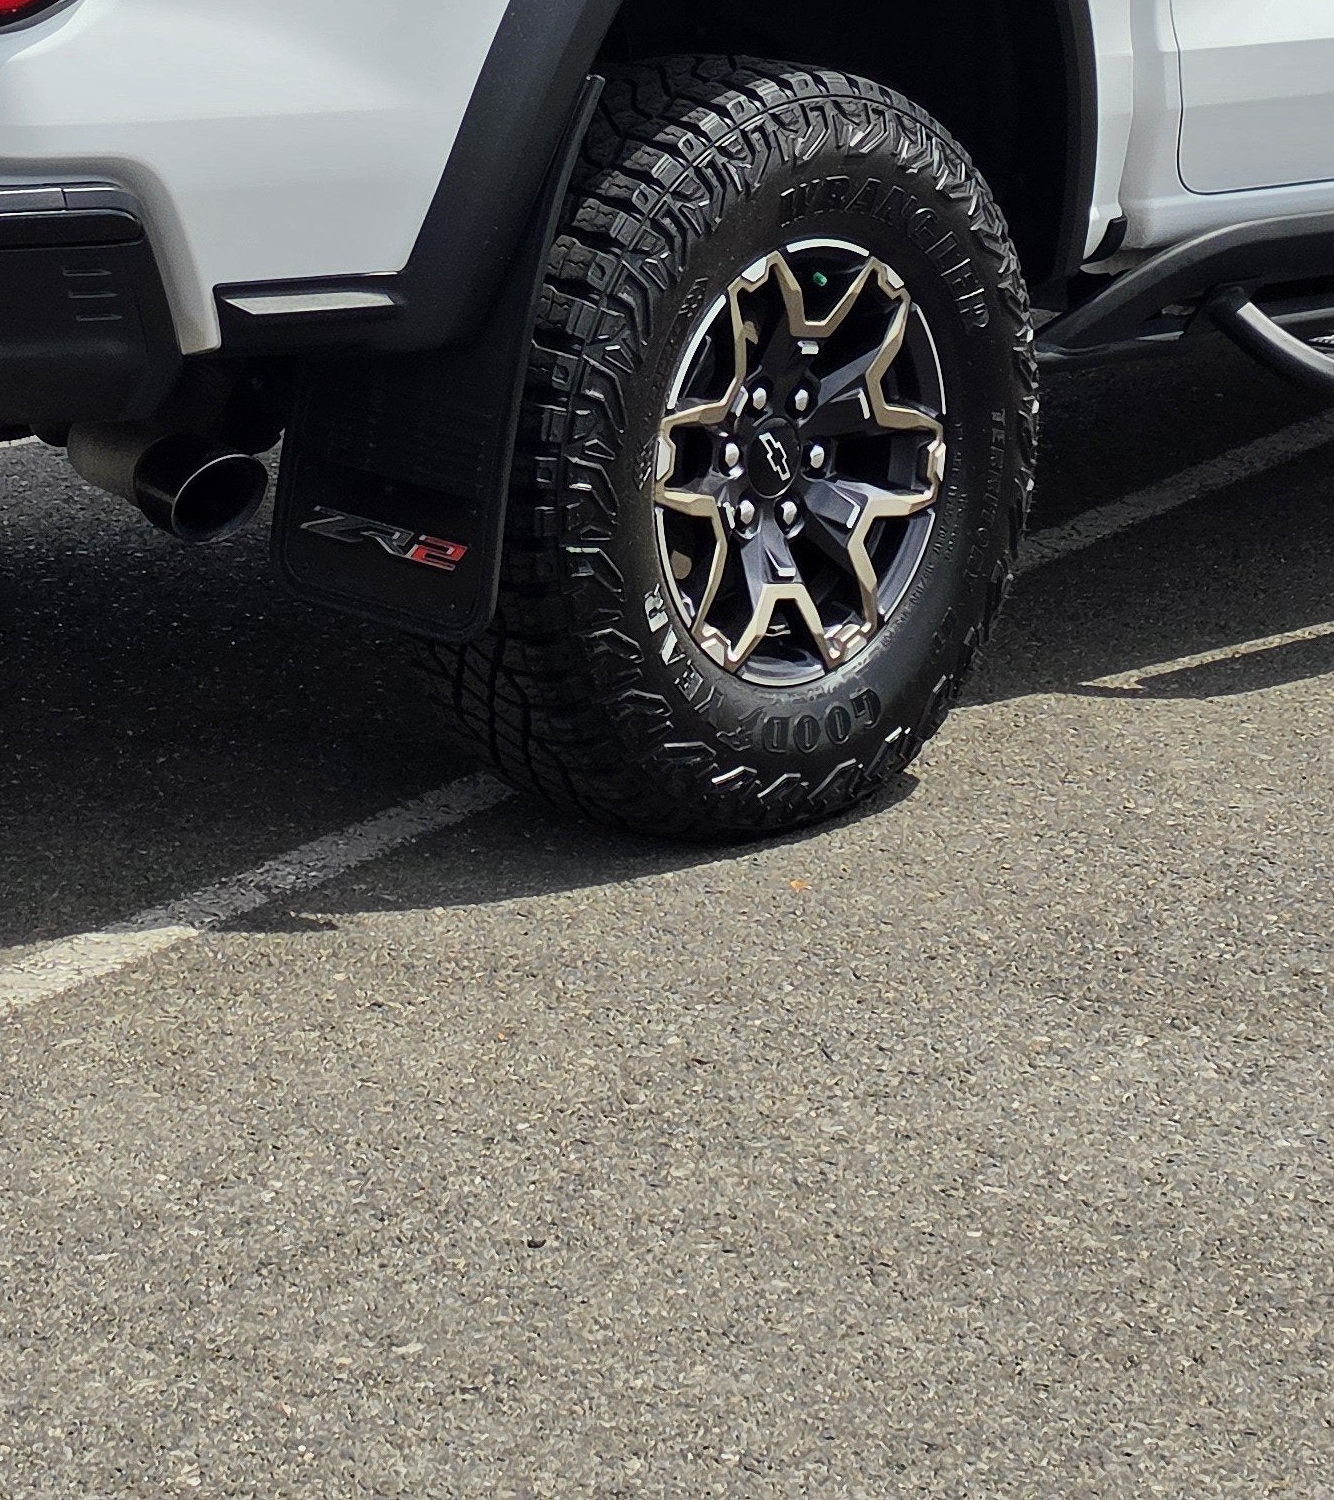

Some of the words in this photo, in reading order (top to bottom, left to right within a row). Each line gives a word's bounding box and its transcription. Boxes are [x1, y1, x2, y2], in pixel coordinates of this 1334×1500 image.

[780, 174, 990, 328] WRANGLER
[300, 505, 468, 571] ZR2
[644, 583, 882, 753] GOODYEAR
